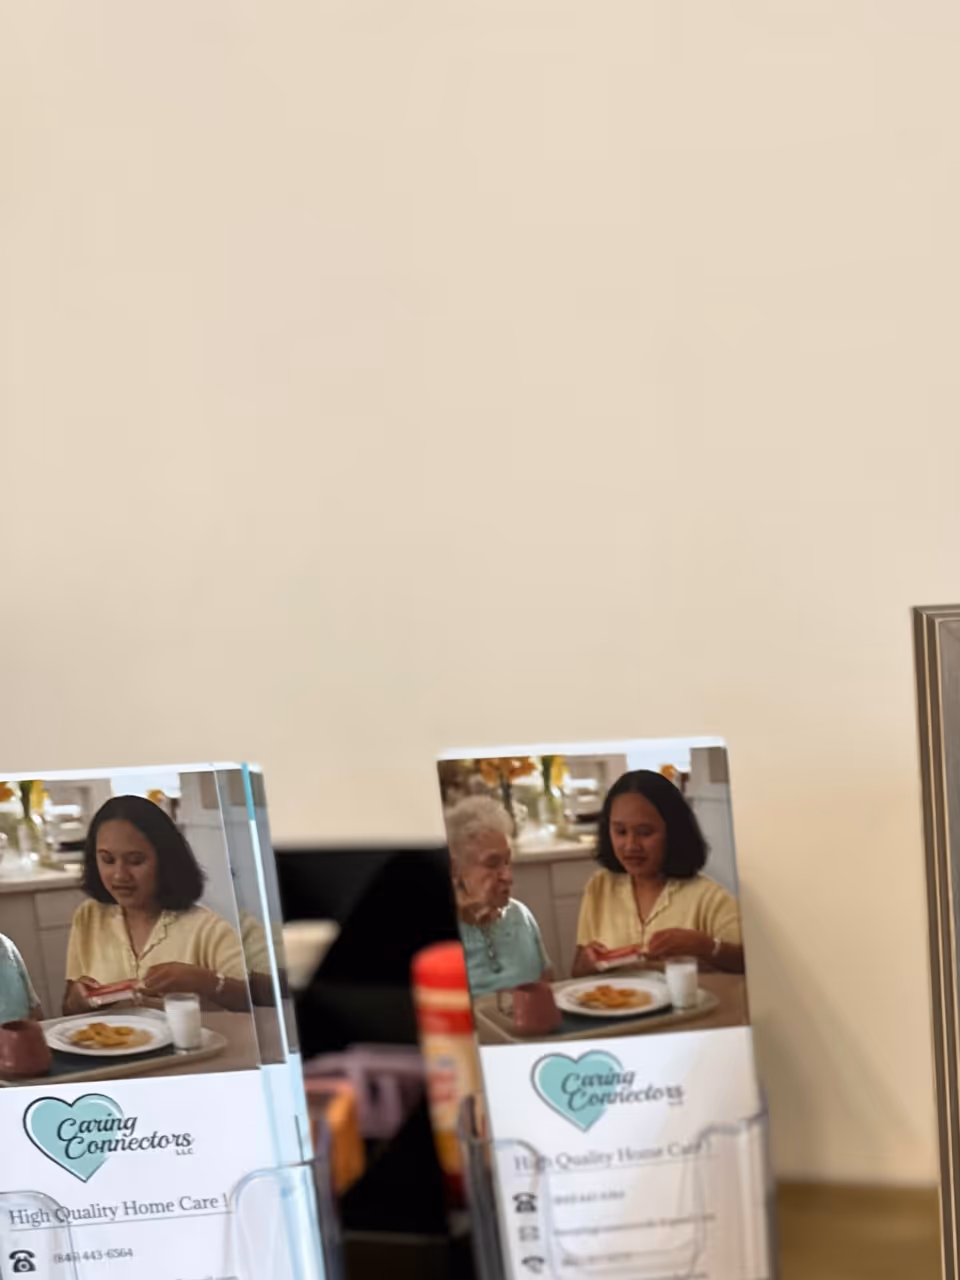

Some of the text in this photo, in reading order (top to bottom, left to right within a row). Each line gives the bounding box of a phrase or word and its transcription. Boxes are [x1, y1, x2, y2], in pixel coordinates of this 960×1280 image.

[57, 1114, 192, 1160] Caring Connectors
[9, 1206, 51, 1227] High
[54, 1203, 118, 1223] Quality
[124, 1201, 175, 1216] Home
[179, 1196, 219, 1211] Care
